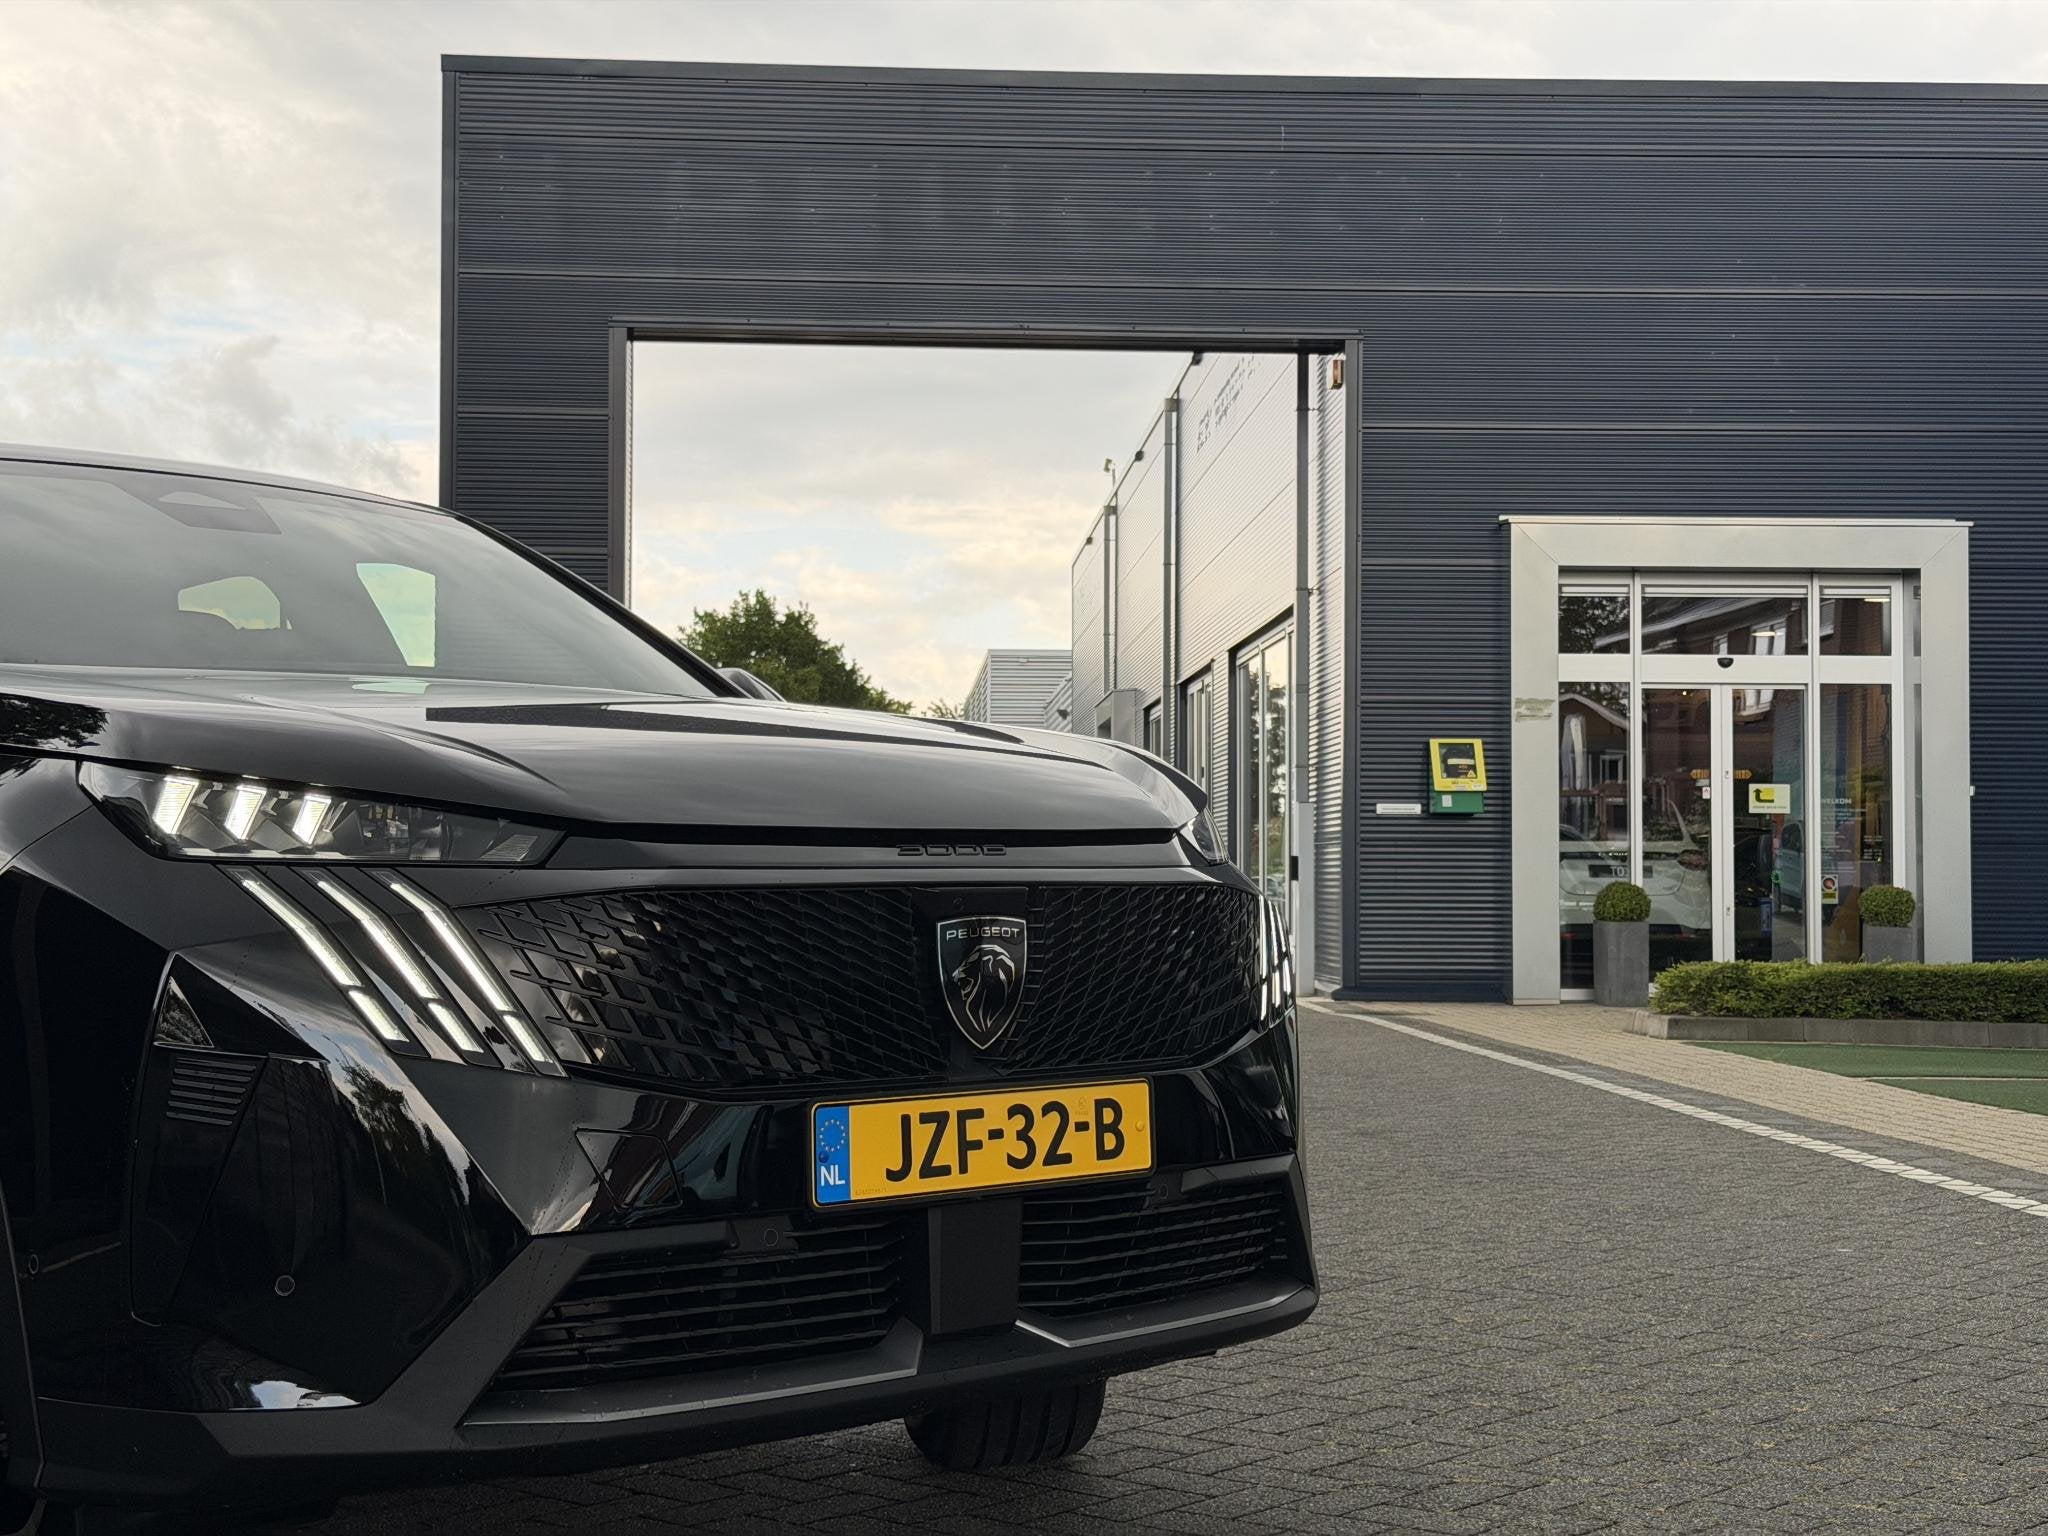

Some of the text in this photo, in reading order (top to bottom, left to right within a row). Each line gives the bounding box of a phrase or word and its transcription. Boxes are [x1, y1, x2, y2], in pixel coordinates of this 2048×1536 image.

[946, 926, 1020, 942] PEUGEOT
[886, 1097, 1126, 1183] JZF-32-B
[820, 1164, 846, 1187] NL
